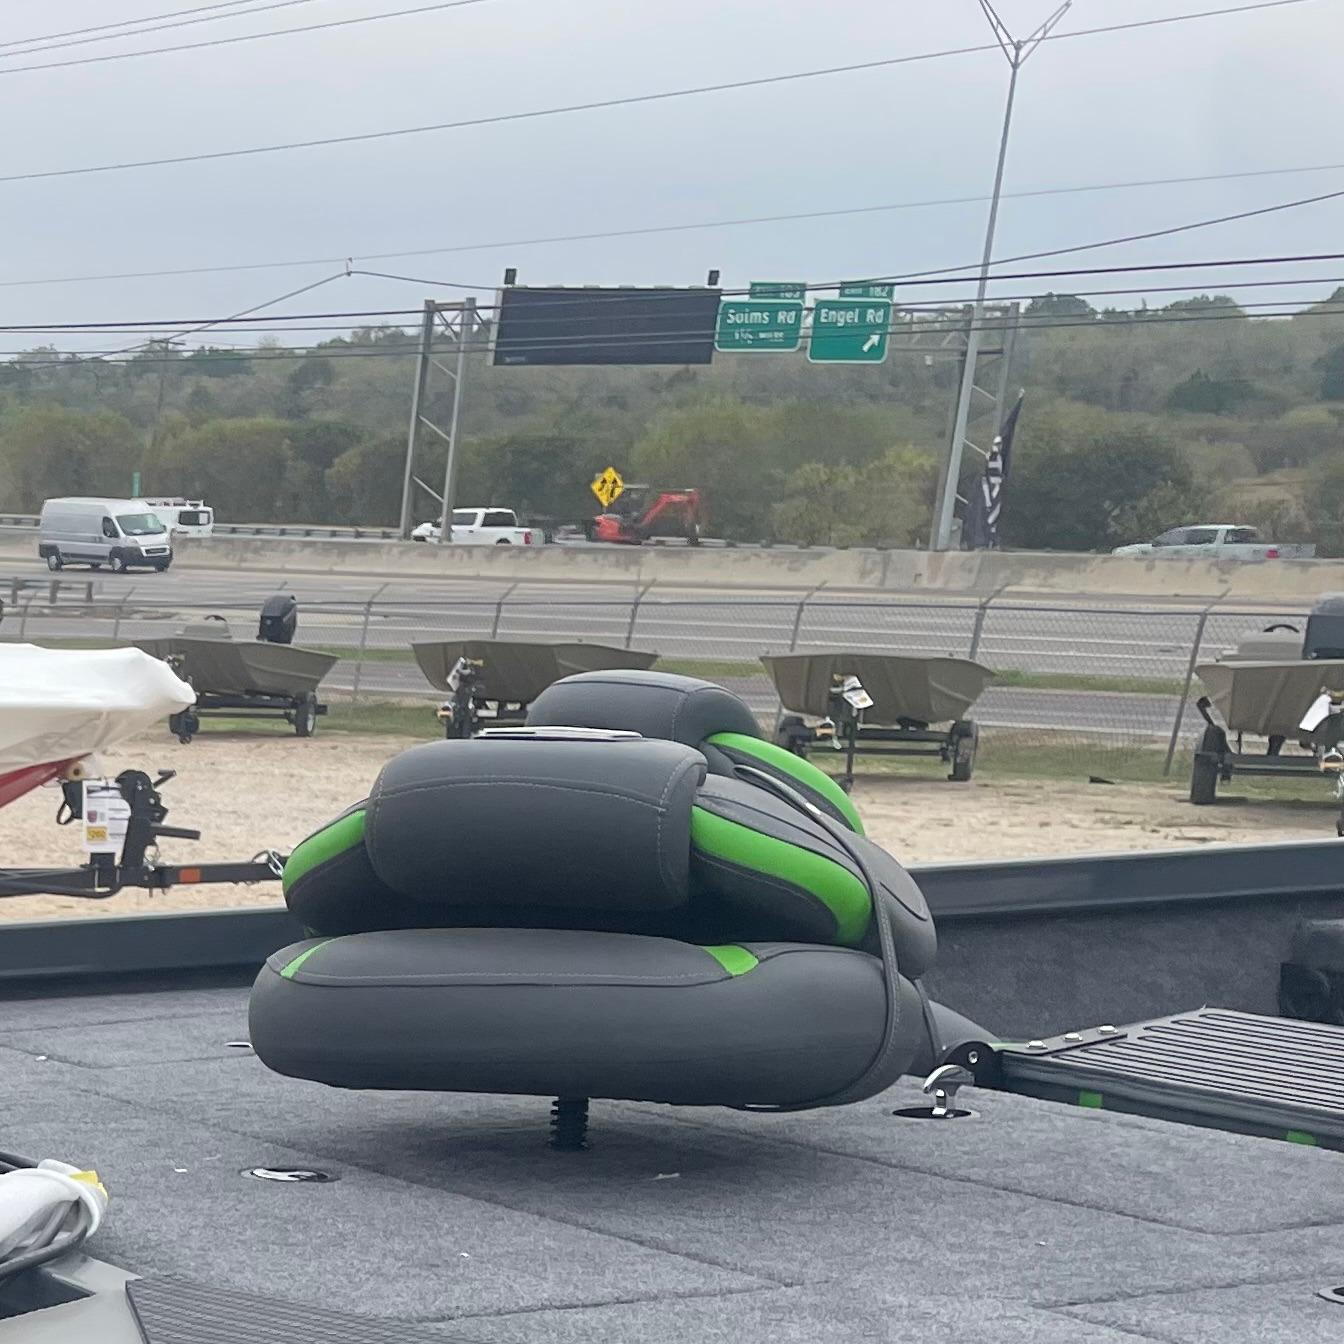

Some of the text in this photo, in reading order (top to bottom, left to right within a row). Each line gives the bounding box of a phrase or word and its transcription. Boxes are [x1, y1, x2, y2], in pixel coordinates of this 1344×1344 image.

[777, 310, 796, 324] Rd
[819, 308, 885, 327] Engel Rd
